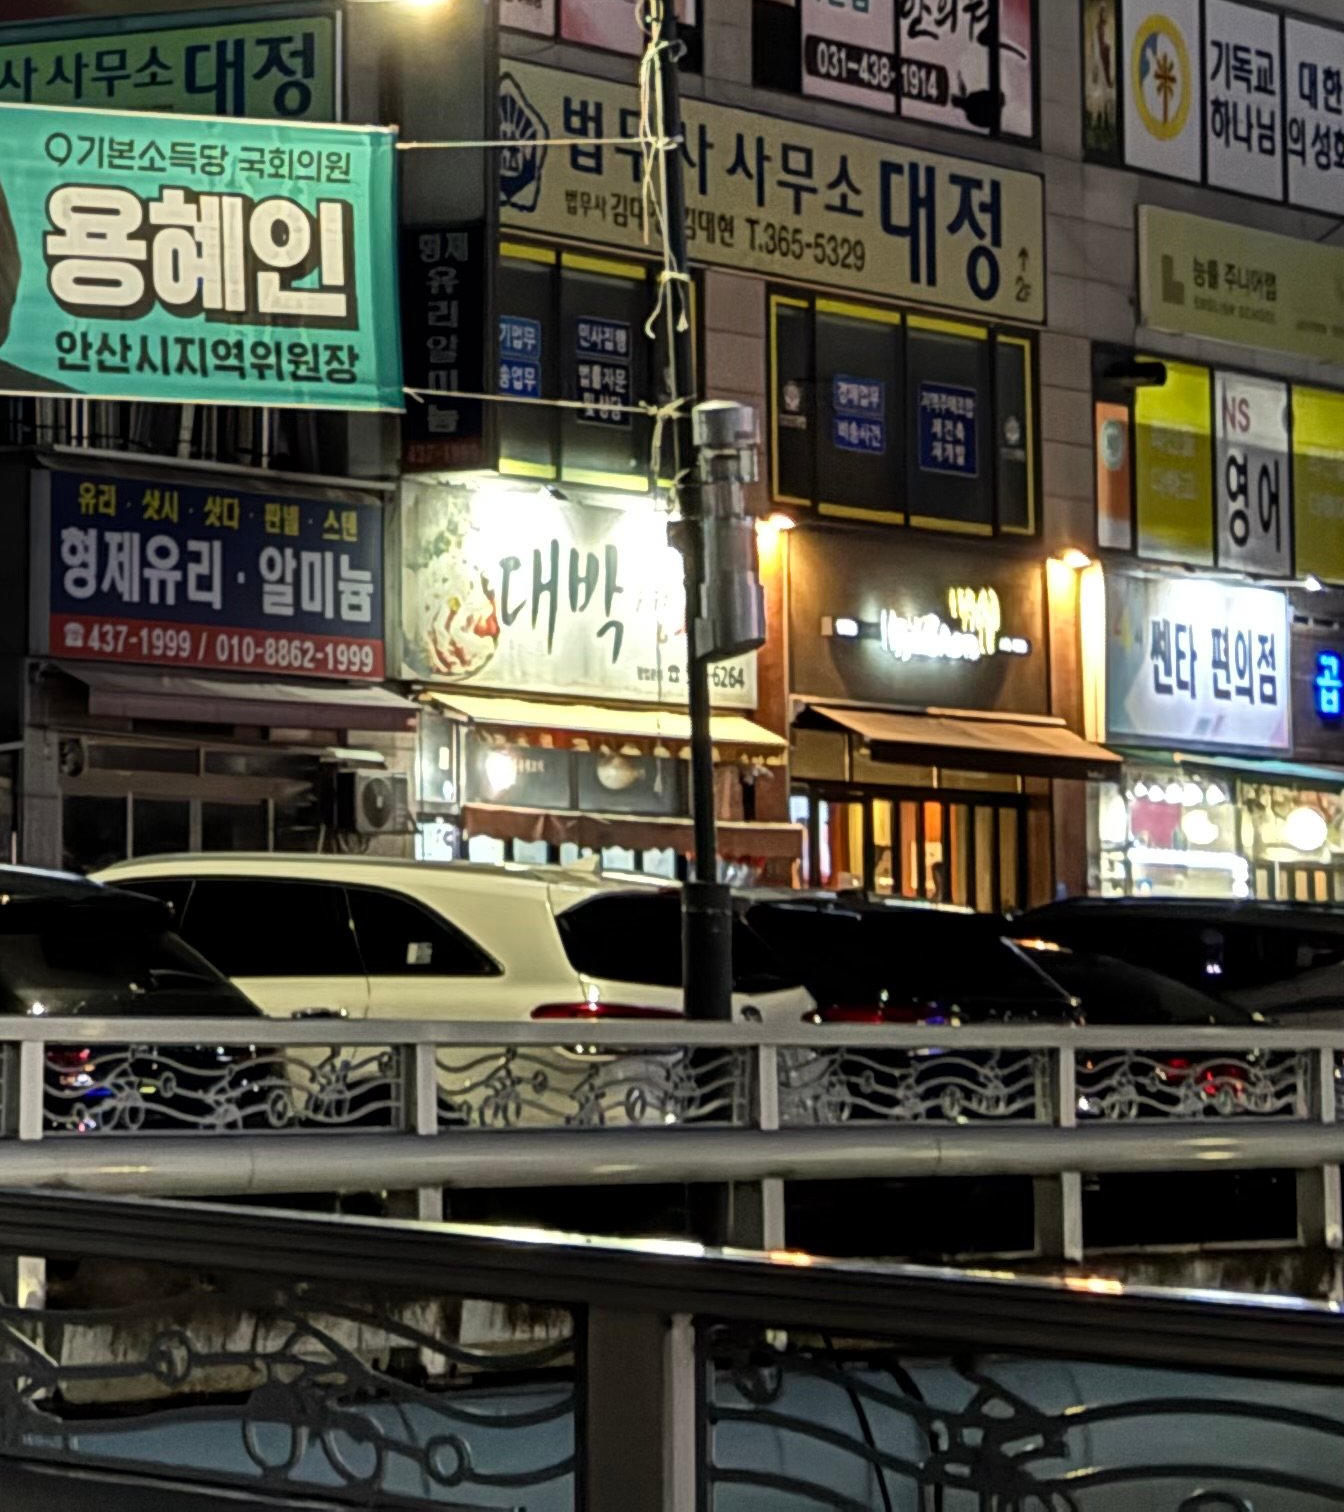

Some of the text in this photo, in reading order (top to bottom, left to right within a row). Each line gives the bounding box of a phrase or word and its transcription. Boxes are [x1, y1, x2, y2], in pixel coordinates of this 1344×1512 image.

[46, 46, 173, 99] 사무소
[185, 31, 316, 118] 대정
[816, 41, 938, 99] 031-438-1914
[1210, 41, 1275, 96] 기독교
[1298, 61, 1342, 115] 대한
[76, 133, 351, 182] 기본소득당 국회의원
[1210, 96, 1275, 156] 하나님
[565, 189, 607, 219] 법무사
[746, 216, 865, 271] T.365-5329
[726, 133, 863, 218] 사무소
[880, 159, 1002, 301] 대정
[45, 186, 348, 318] 용혜인
[55, 331, 359, 384] 안산시지역위원장
[78, 482, 116, 517] 유리
[1226, 452, 1281, 552] 영어
[60, 526, 373, 622] 형제유리 알미늄
[499, 538, 624, 664] 대박
[87, 622, 374, 674] 437-1999 010-8862-1999
[1211, 628, 1278, 707] 편의점
